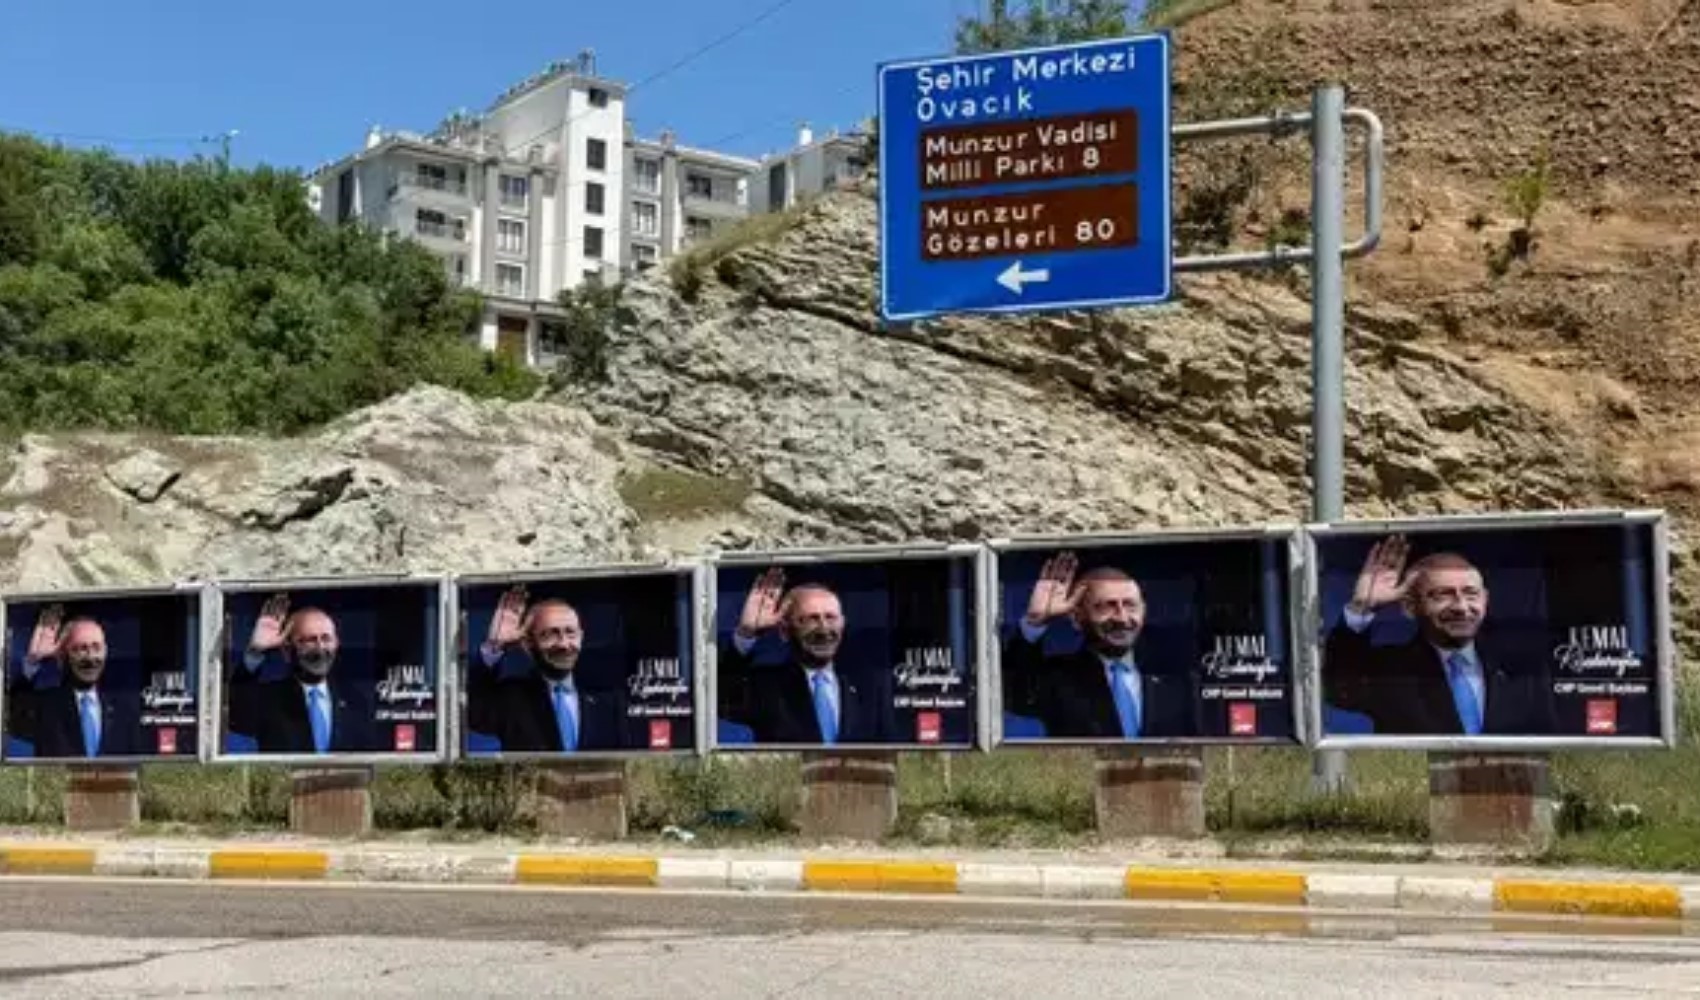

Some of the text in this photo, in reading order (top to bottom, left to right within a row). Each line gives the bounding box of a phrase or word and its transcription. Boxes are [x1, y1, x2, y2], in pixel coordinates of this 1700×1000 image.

[917, 47, 1135, 95] Şehir Merkezi
[917, 87, 1033, 122] Ovacık
[925, 132, 1028, 158] Munzur
[995, 152, 1065, 176] Parkı
[1082, 147, 1100, 168] 8
[927, 203, 1045, 228] Munzur
[927, 218, 1115, 255] Gözeleri 80
